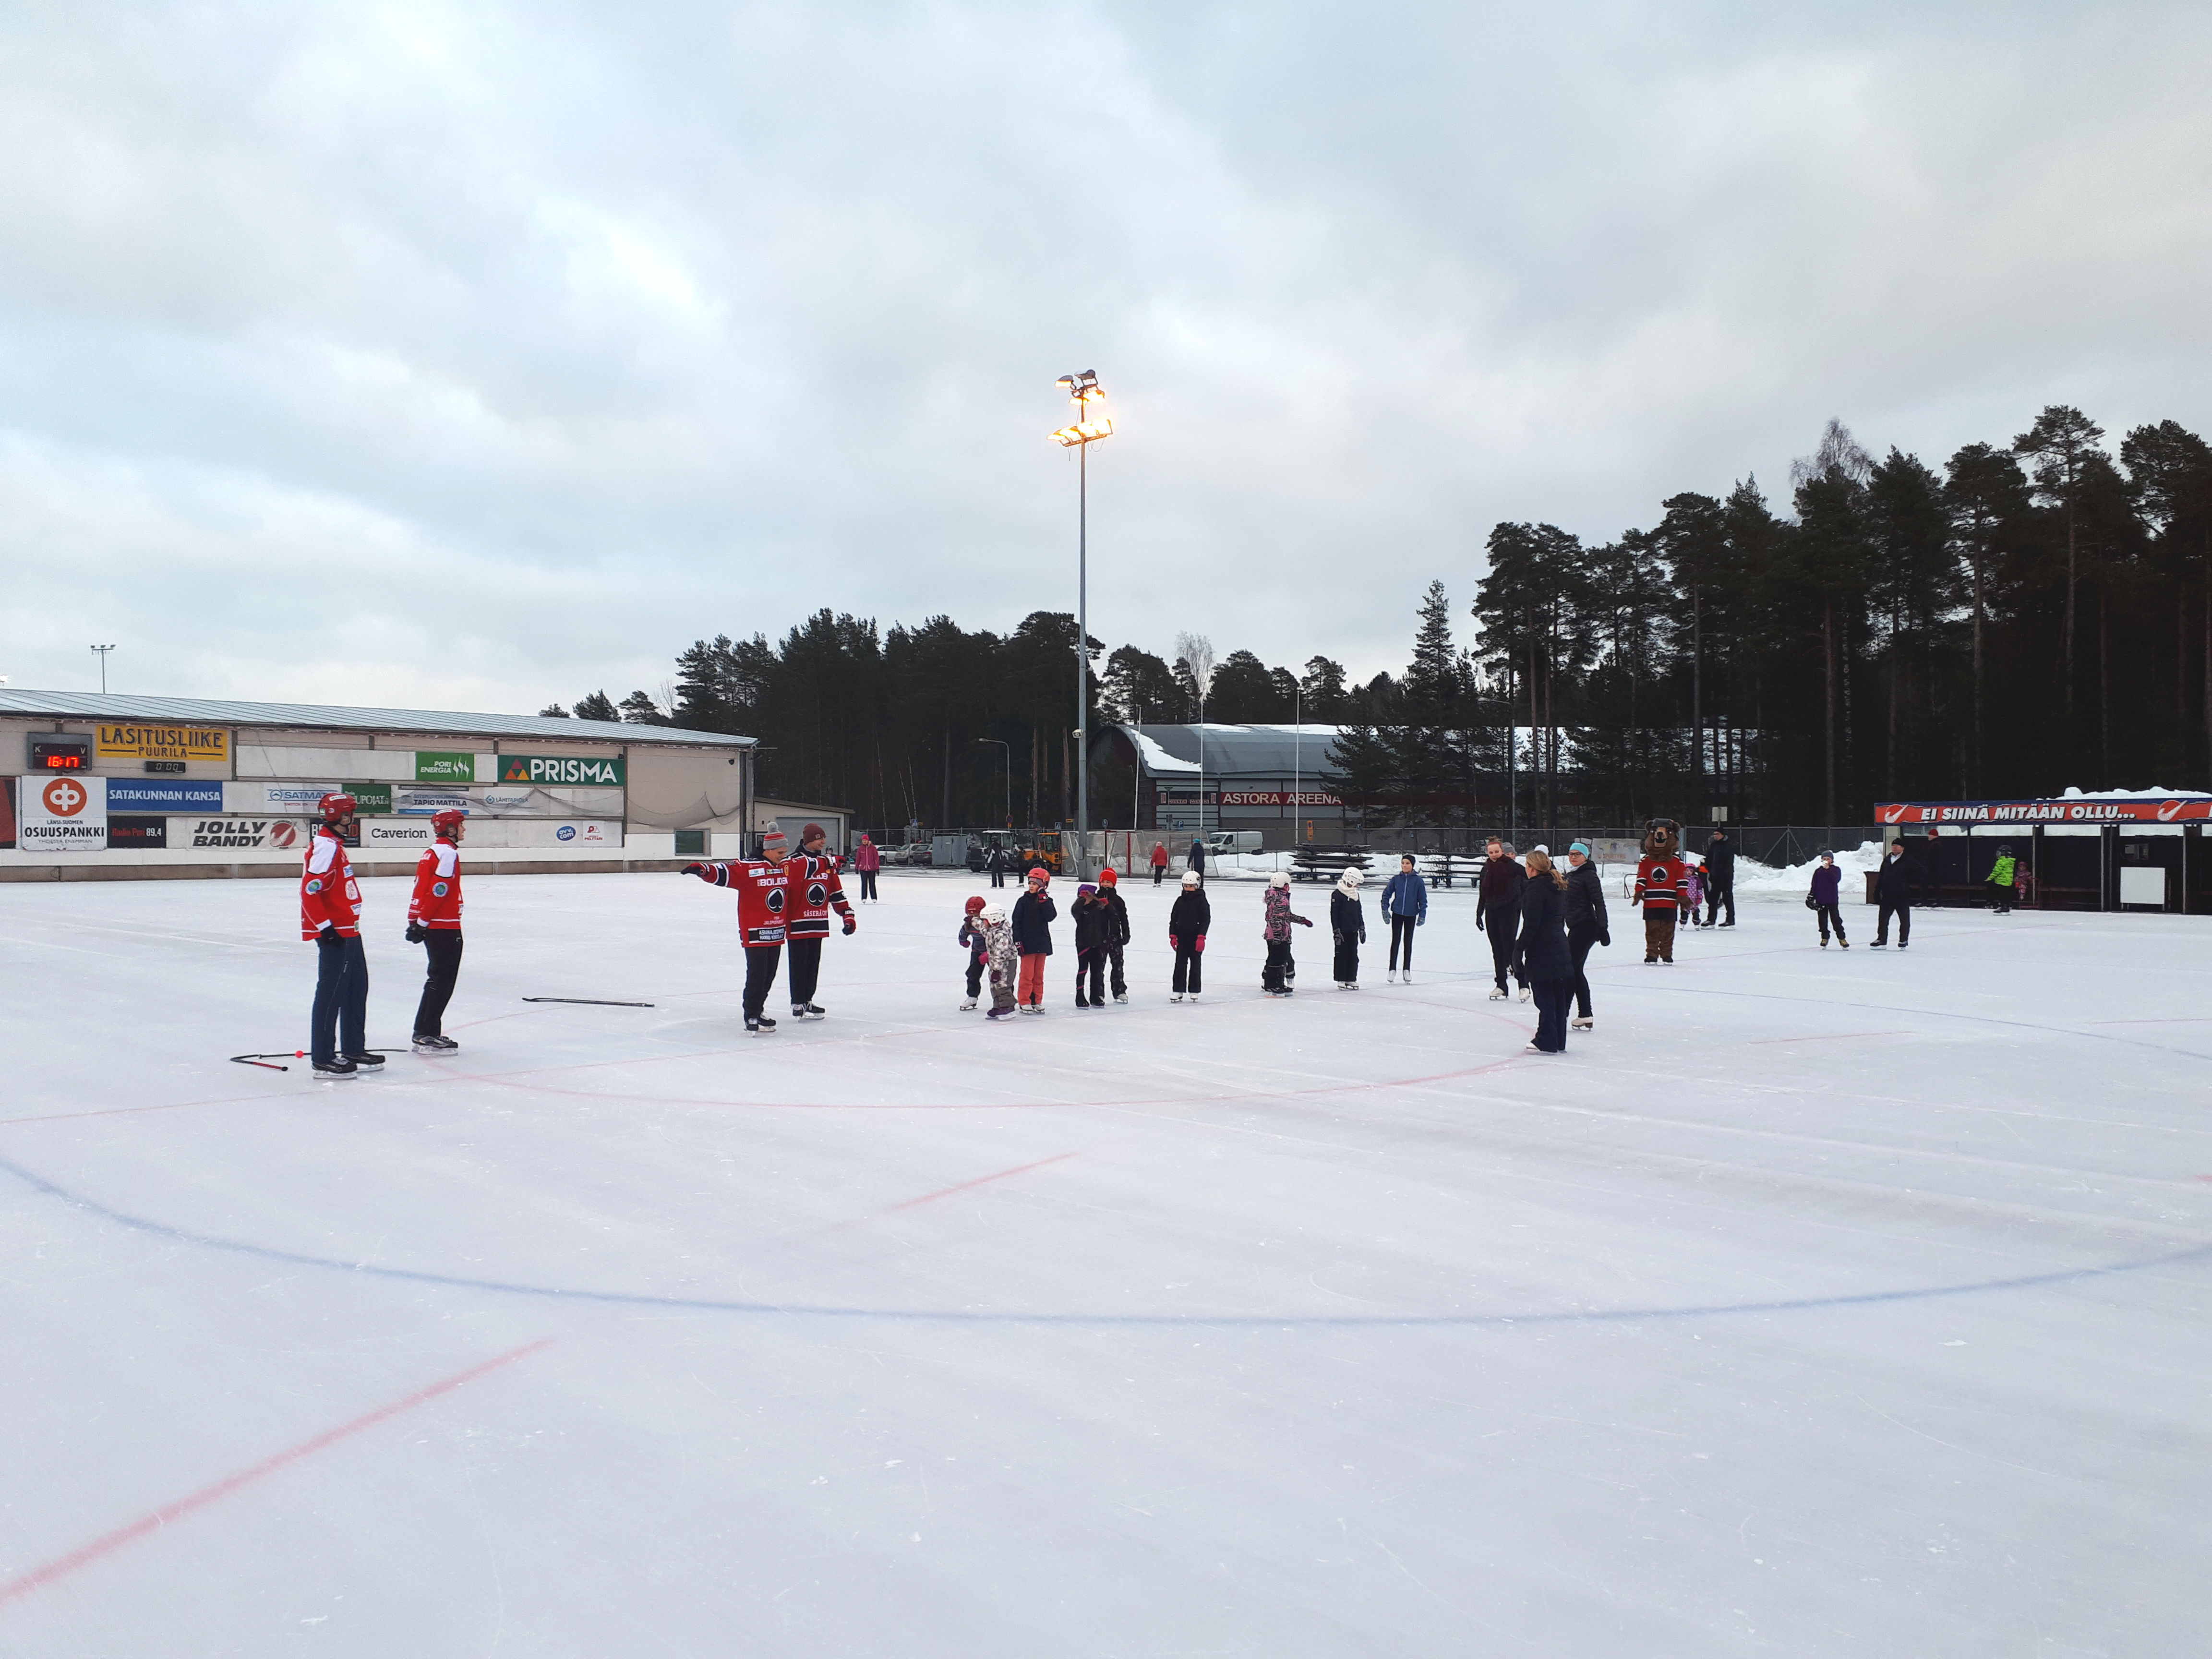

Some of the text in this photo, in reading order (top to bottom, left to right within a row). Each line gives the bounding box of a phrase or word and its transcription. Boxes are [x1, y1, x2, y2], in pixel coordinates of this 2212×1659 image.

[100, 727, 223, 749] LASITUSLIIKE
[138, 746, 188, 757] PUURILA
[47, 756, 80, 768] 16:17
[530, 758, 618, 783] PRISMA
[109, 790, 221, 801] SATAKUNNAN KANSA
[1222, 793, 1280, 804] ASTORA
[1286, 793, 1342, 804] AREENA
[1921, 803, 2135, 820] EI SIINÄ MITÄÄN OLLU...
[24, 827, 104, 837] OSUUSPANKKI
[146, 828, 162, 837] 89.4
[193, 821, 267, 834] JOLLY
[371, 828, 428, 838] Caverion
[192, 836, 265, 847] BANDY
